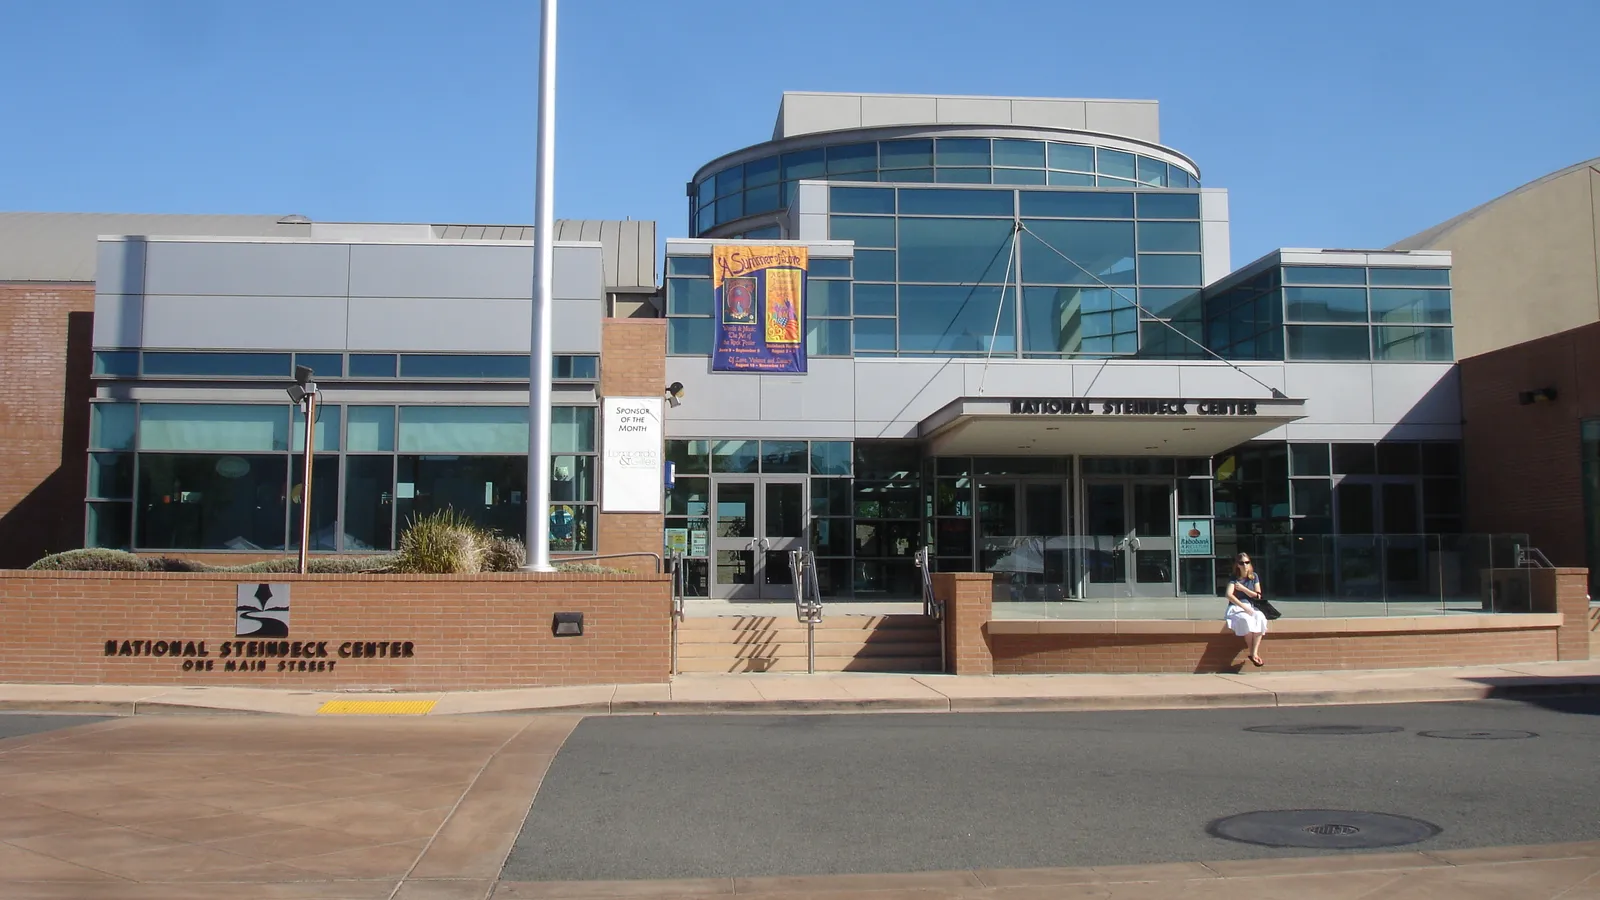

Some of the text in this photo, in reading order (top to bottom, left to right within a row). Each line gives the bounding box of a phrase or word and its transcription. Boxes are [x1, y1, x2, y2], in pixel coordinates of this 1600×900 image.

[718, 256, 734, 282] A
[731, 252, 774, 275] Summer
[781, 249, 801, 265] Love
[1010, 400, 1258, 415] NATIONAL STEINBECK CENTER
[619, 454, 631, 466] &
[104, 640, 415, 658] NATIONAL STEINBECK CENTER
[182, 660, 337, 672] ONE MAIN STREET
